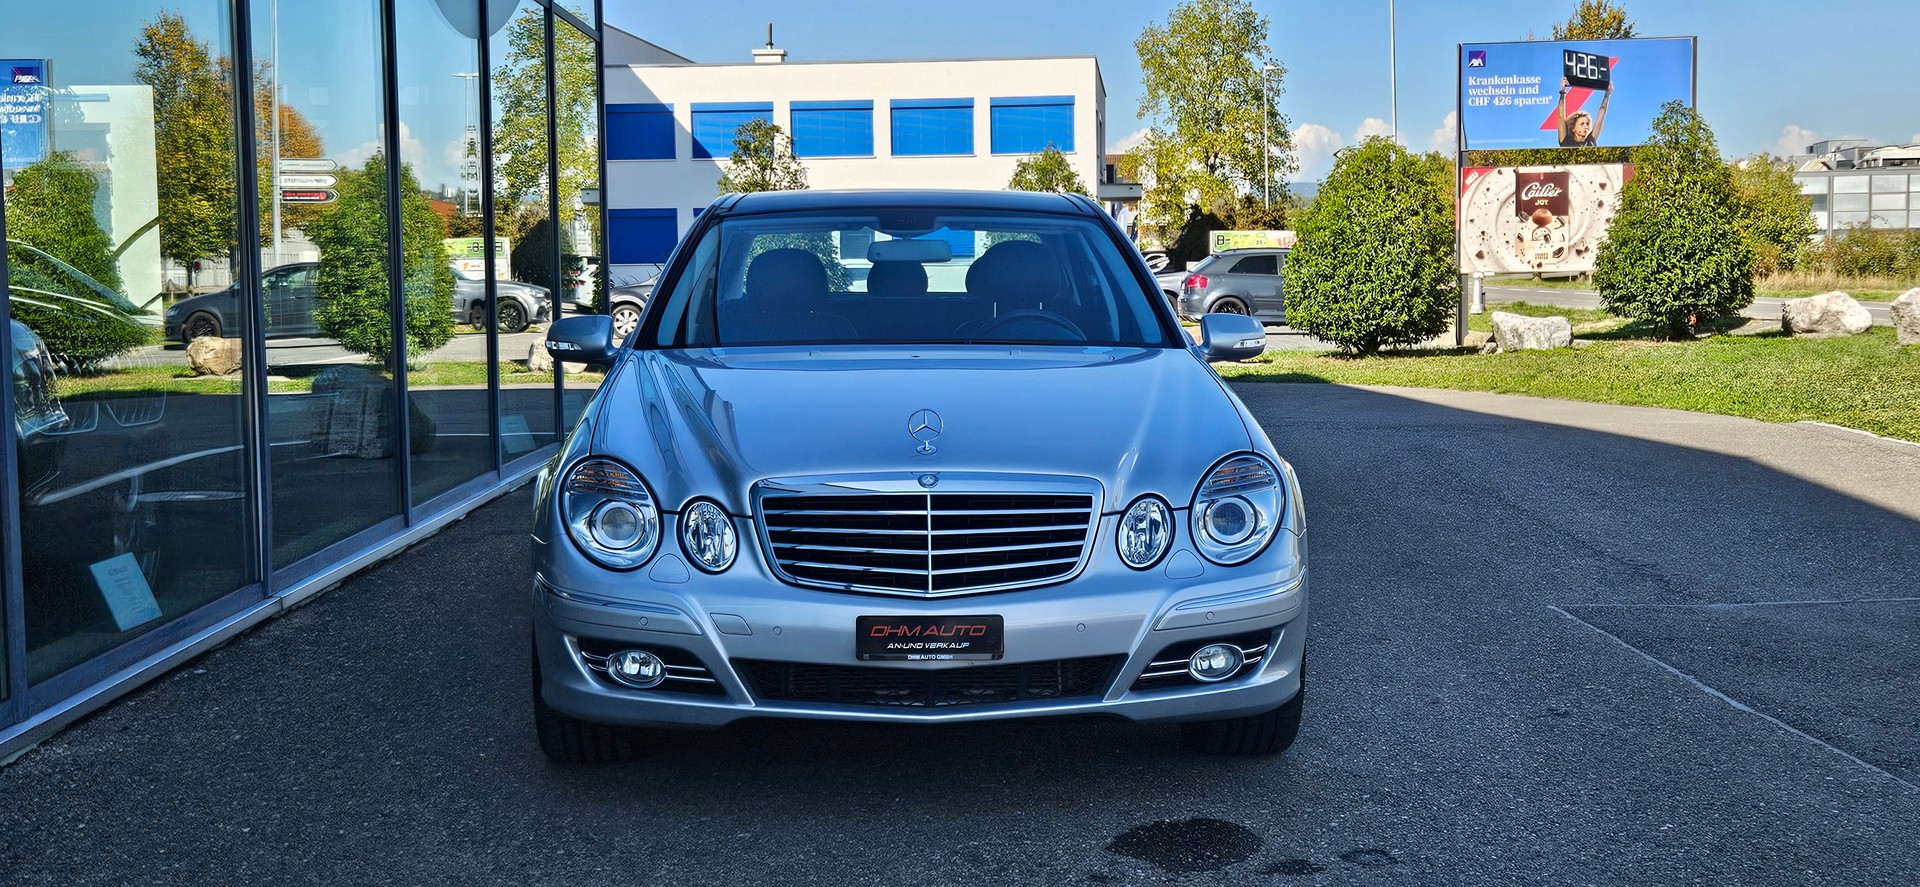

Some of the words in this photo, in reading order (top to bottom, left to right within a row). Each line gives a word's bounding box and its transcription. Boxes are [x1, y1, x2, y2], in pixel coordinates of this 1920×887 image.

[1469, 58, 1484, 67] AXA
[1468, 75, 1541, 85] Krankenkasse
[1468, 86, 1516, 96] wechseln
[1519, 85, 1539, 94] und
[1468, 97, 1490, 106] CHF
[1493, 96, 1512, 106] 426
[1521, 182, 1562, 200] Cailler
[923, 625, 987, 636] AUTO
